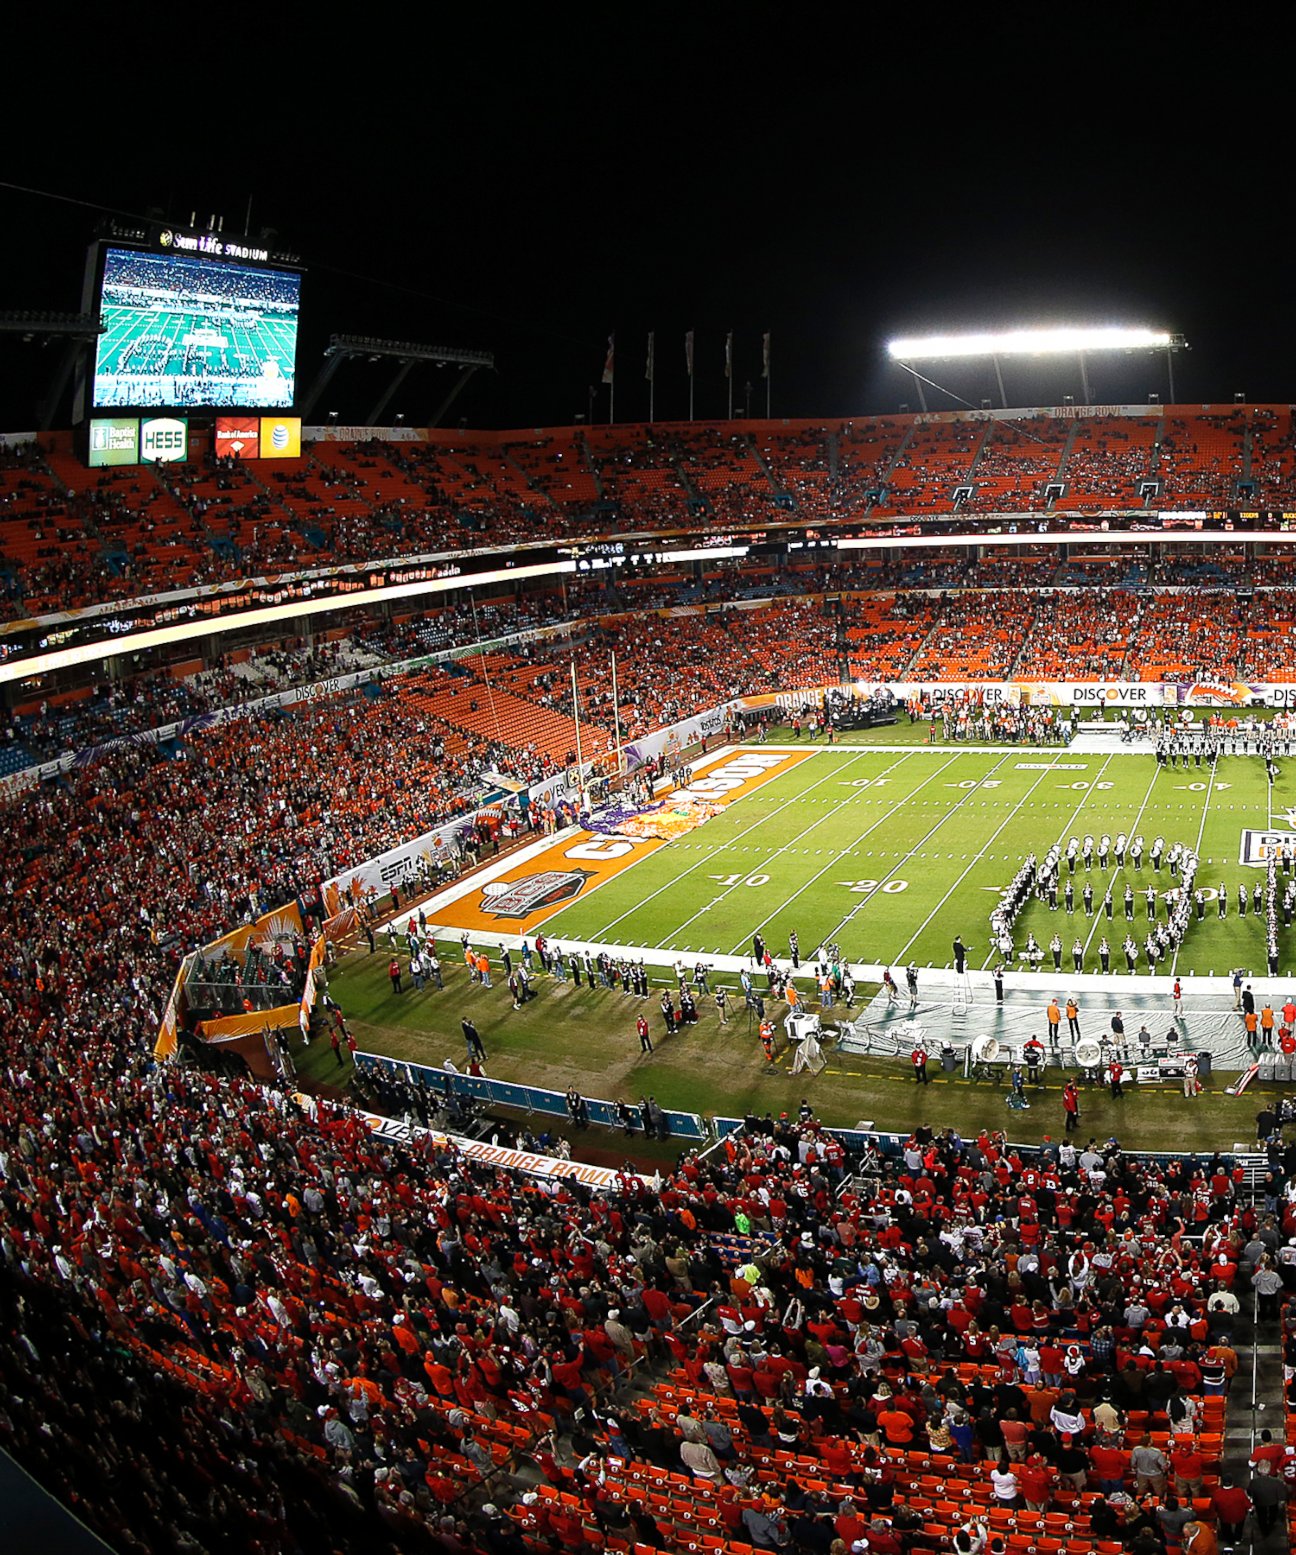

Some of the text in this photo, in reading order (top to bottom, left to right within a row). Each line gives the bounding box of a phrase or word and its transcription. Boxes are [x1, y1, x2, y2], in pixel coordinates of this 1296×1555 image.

[173, 233, 268, 261] Sun Life STADIUM
[109, 427, 136, 438] Baptist
[236, 430, 258, 439] America
[109, 437, 134, 450] Health
[145, 431, 183, 449] HESS
[295, 680, 340, 701] DISCOVER
[1073, 688, 1146, 701] DISCOVER
[775, 689, 824, 709] ORANGE
[379, 857, 411, 882] ESPN
[717, 873, 771, 887] 10
[850, 879, 910, 893] 20
[465, 1145, 611, 1186] ORANGE BOWL
[1027, 1174, 1034, 1184] 2
[1192, 1276, 1200, 1286] 5
[969, 1335, 977, 1345] 5
